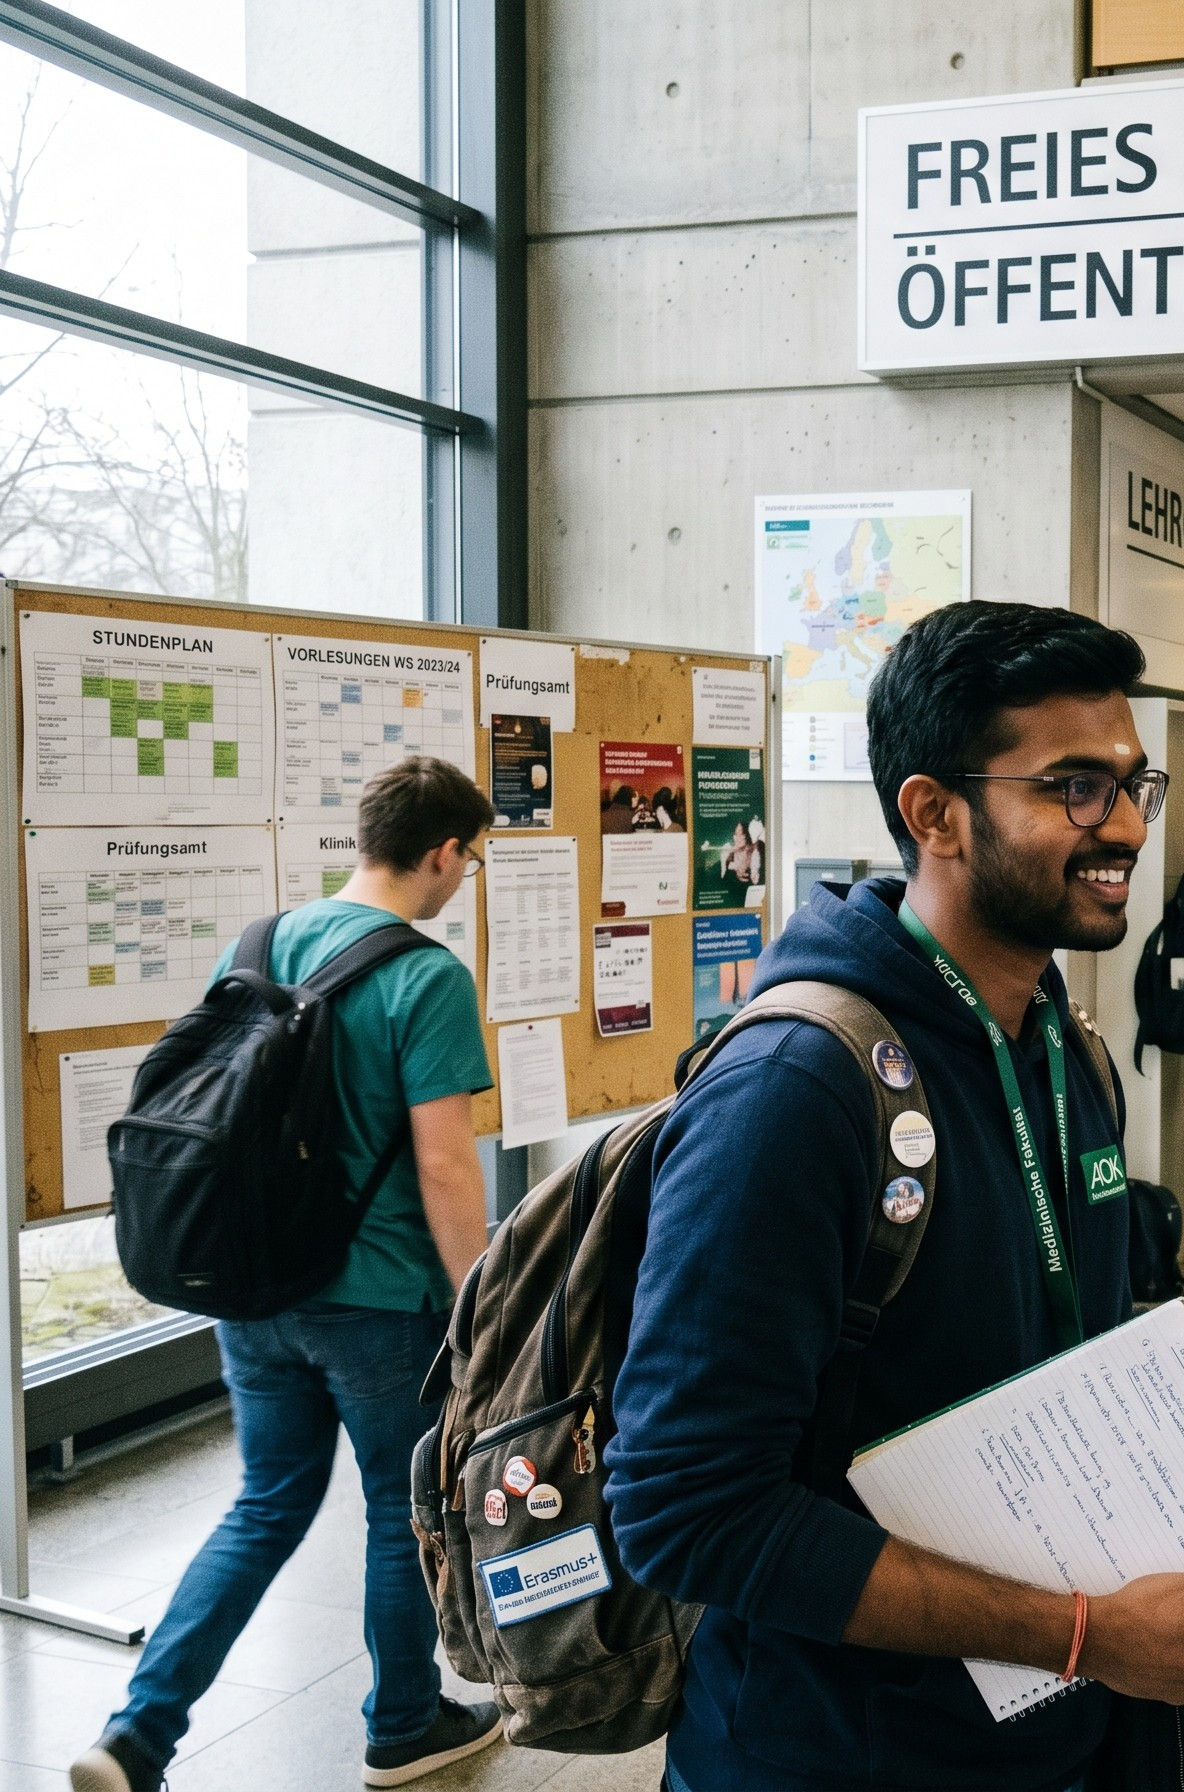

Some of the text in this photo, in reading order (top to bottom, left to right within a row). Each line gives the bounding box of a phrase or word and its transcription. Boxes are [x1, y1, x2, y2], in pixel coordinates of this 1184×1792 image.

[907, 122, 1158, 210] FREIES
[92, 630, 213, 654] STUNDENPLAN
[287, 647, 461, 674] VORLESUNGEN WS 2023/24
[486, 674, 570, 695] Prüfungsamt
[106, 840, 207, 859] Prüfungsamt
[319, 837, 357, 850] Klinik
[1091, 1154, 1124, 1190] AOK
[1024, 1172, 1063, 1273] Medizinische
[524, 1552, 597, 1590] Erasmus+
